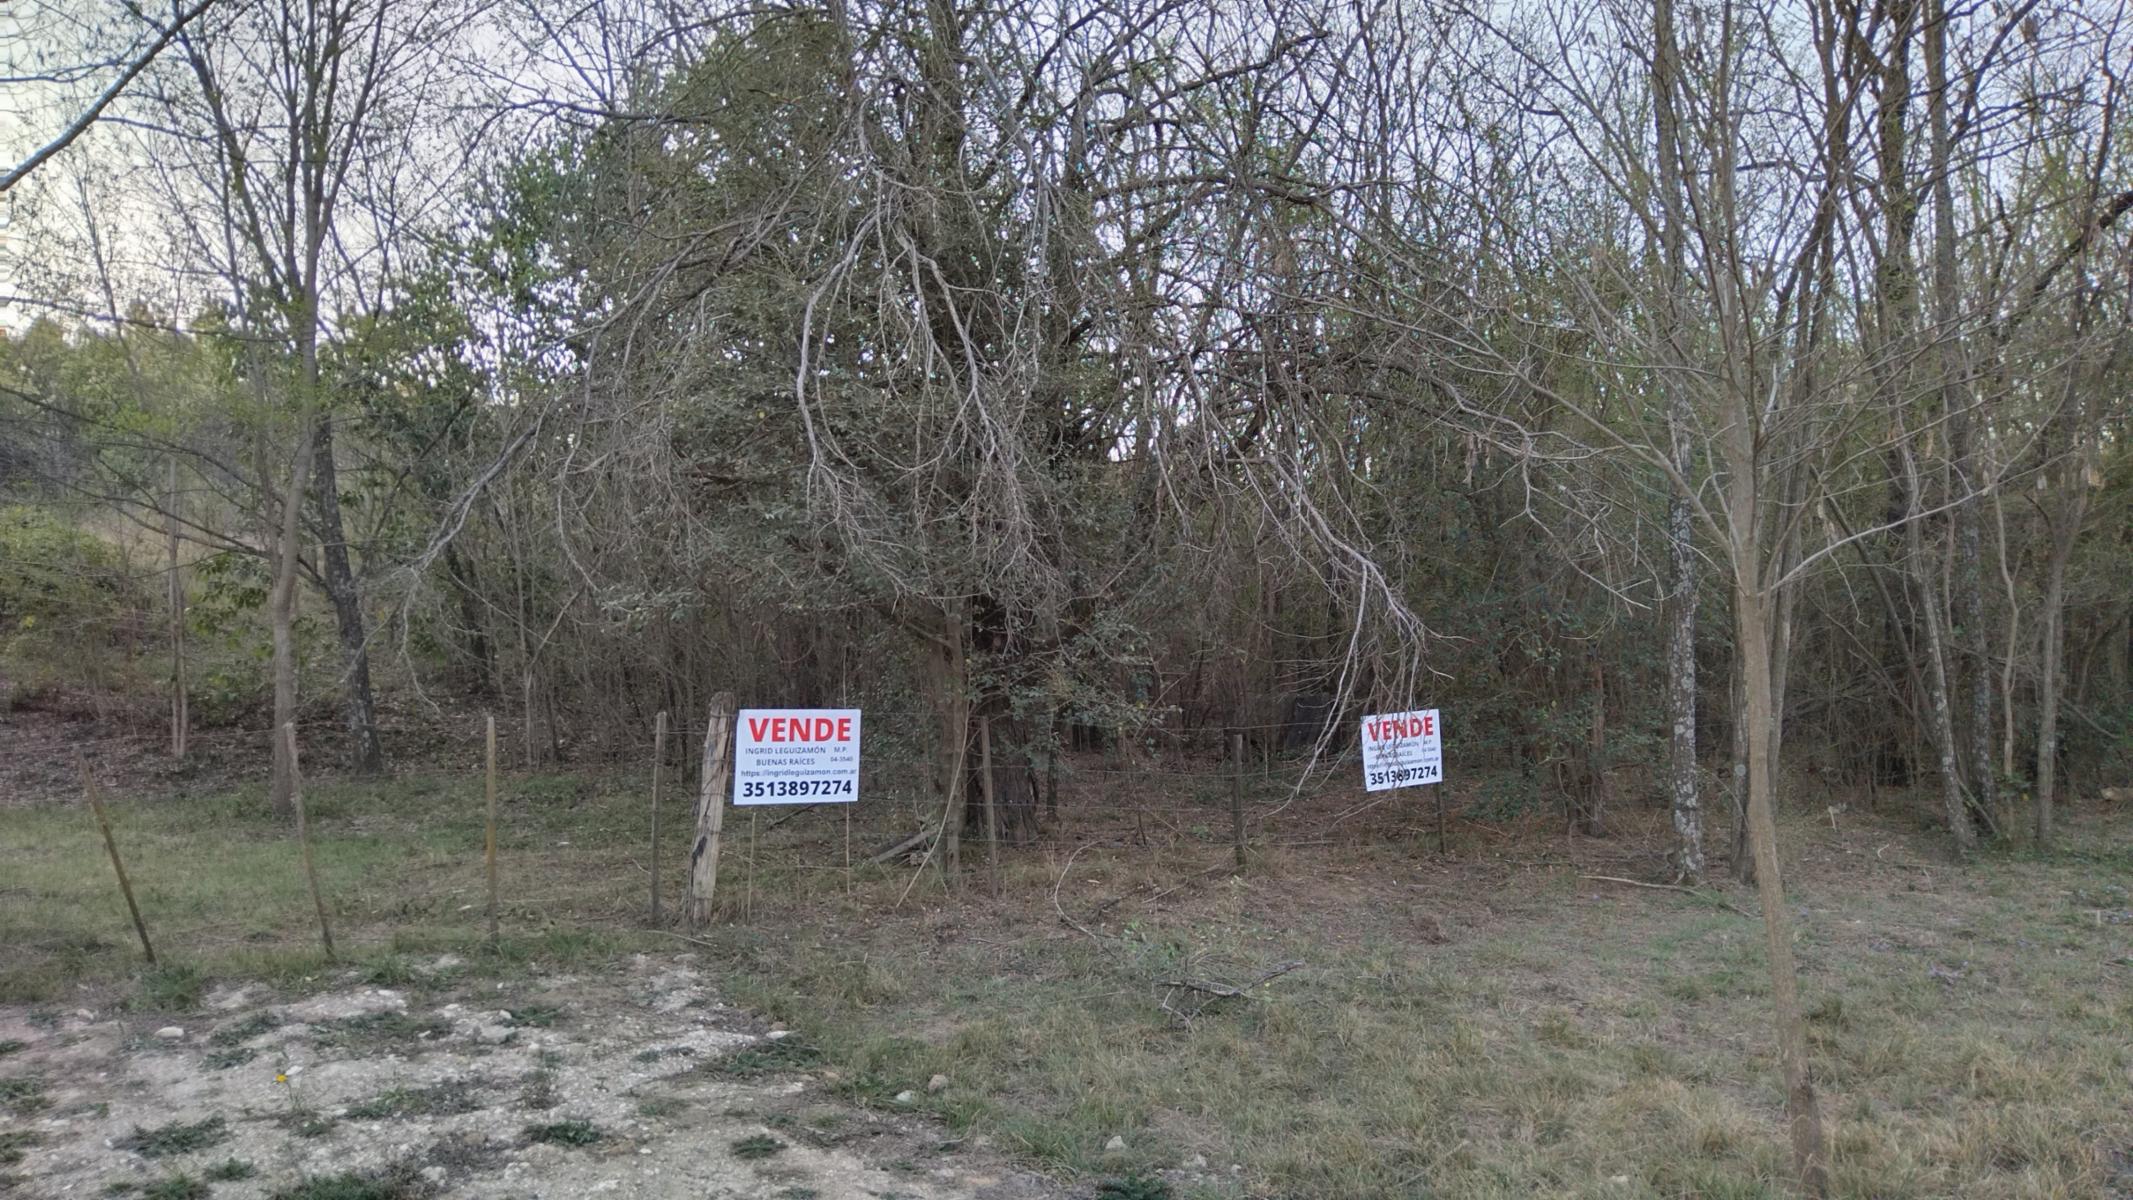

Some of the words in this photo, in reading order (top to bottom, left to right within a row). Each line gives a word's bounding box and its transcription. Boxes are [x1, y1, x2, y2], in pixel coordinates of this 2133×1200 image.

[748, 718, 852, 742] VENDE
[1367, 716, 1434, 742] VENDE
[745, 747, 774, 755] INGRID
[774, 745, 826, 755] LEGUIZAMÓN
[789, 757, 816, 766] RAÍCES
[743, 780, 852, 797] 3513897274
